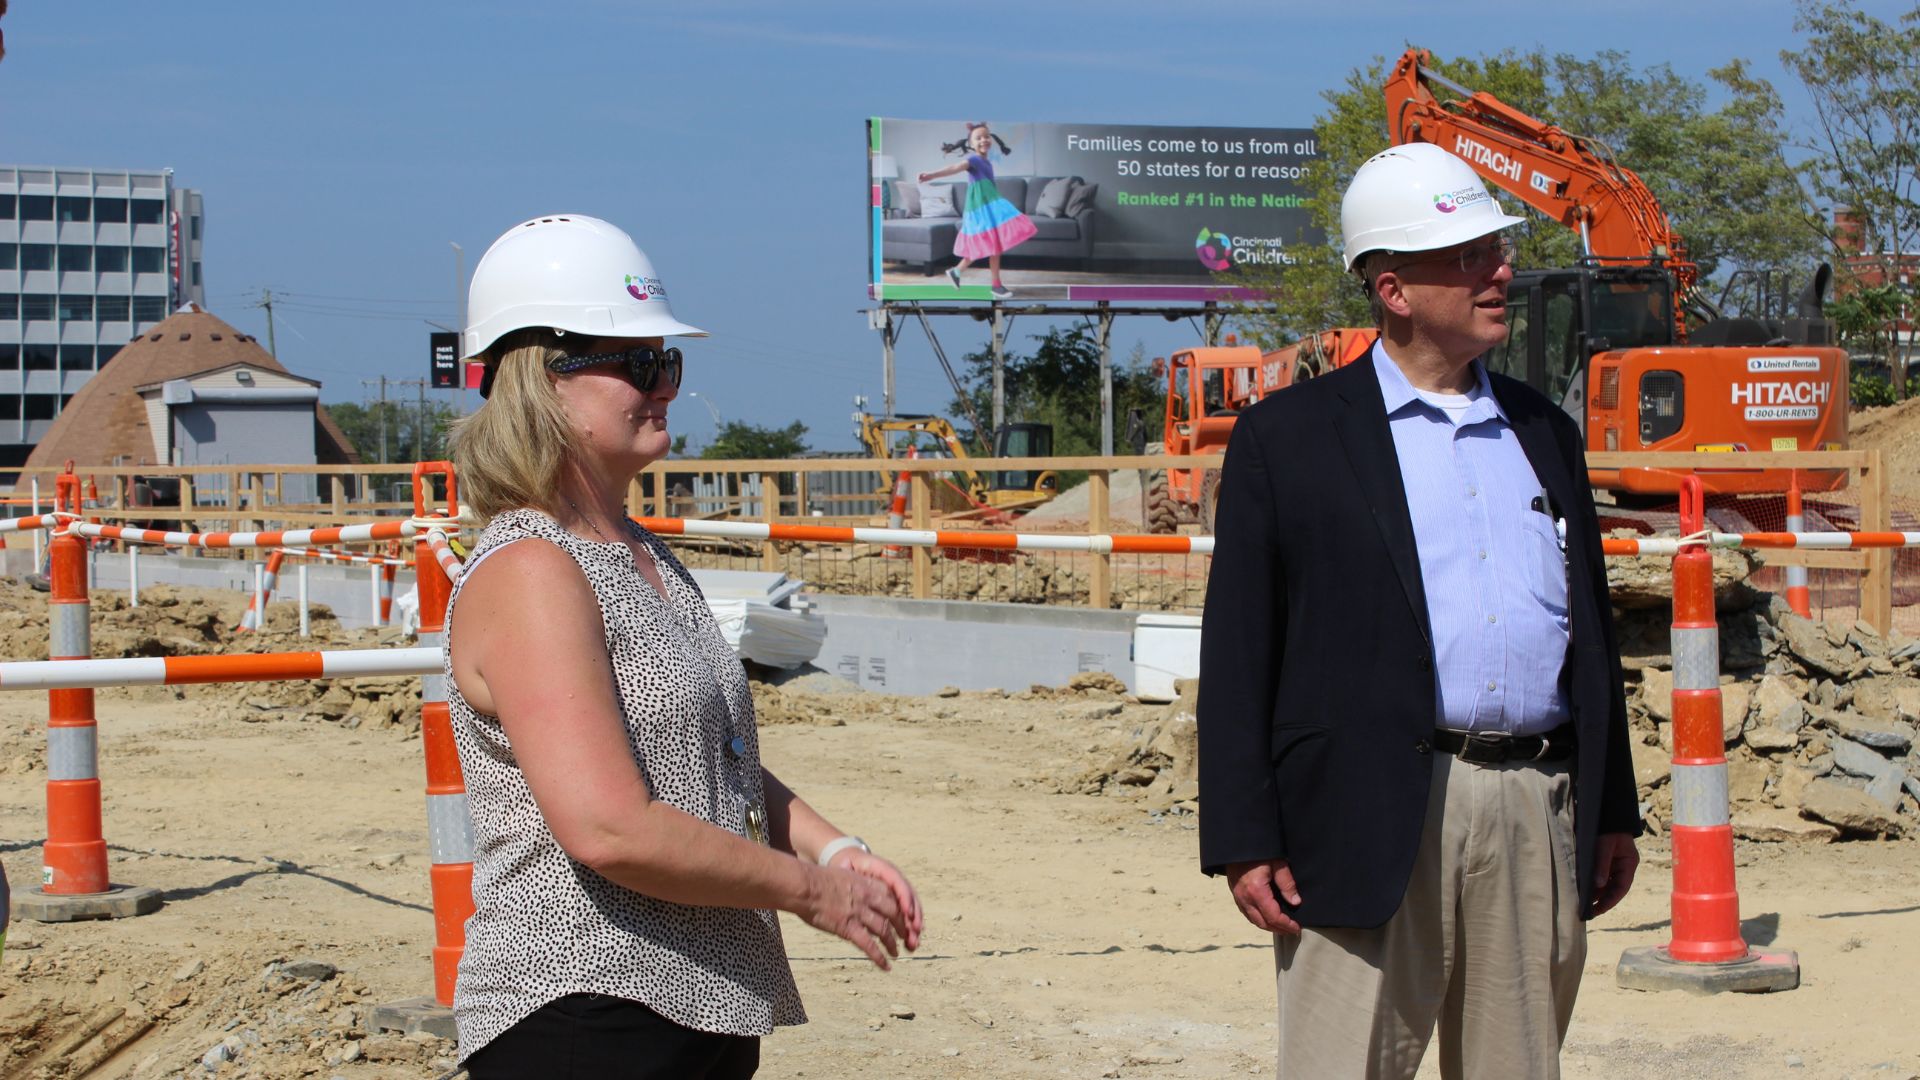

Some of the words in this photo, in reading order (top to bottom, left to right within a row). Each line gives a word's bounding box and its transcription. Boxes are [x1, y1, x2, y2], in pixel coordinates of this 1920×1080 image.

[1067, 134, 1142, 151] Families
[1147, 139, 1196, 152] come
[1201, 138, 1219, 153] to
[1224, 141, 1244, 154] us
[1249, 138, 1288, 154] from
[1294, 140, 1316, 155] all
[1455, 135, 1522, 182] HITACHI
[1117, 160, 1141, 176] 50
[1146, 162, 1200, 177] states
[1205, 161, 1230, 177] for
[1235, 165, 1246, 178] a
[1118, 192, 1180, 206] Ranked
[1185, 193, 1204, 206] #1
[1209, 193, 1225, 207] in
[1230, 193, 1257, 207] the
[1261, 193, 1312, 208] Natio
[1763, 360, 1790, 369] United
[1792, 360, 1817, 369] Rentals
[1731, 382, 1830, 404] HITACHI
[1748, 408, 1817, 419] 1-800-UR-RENTS
